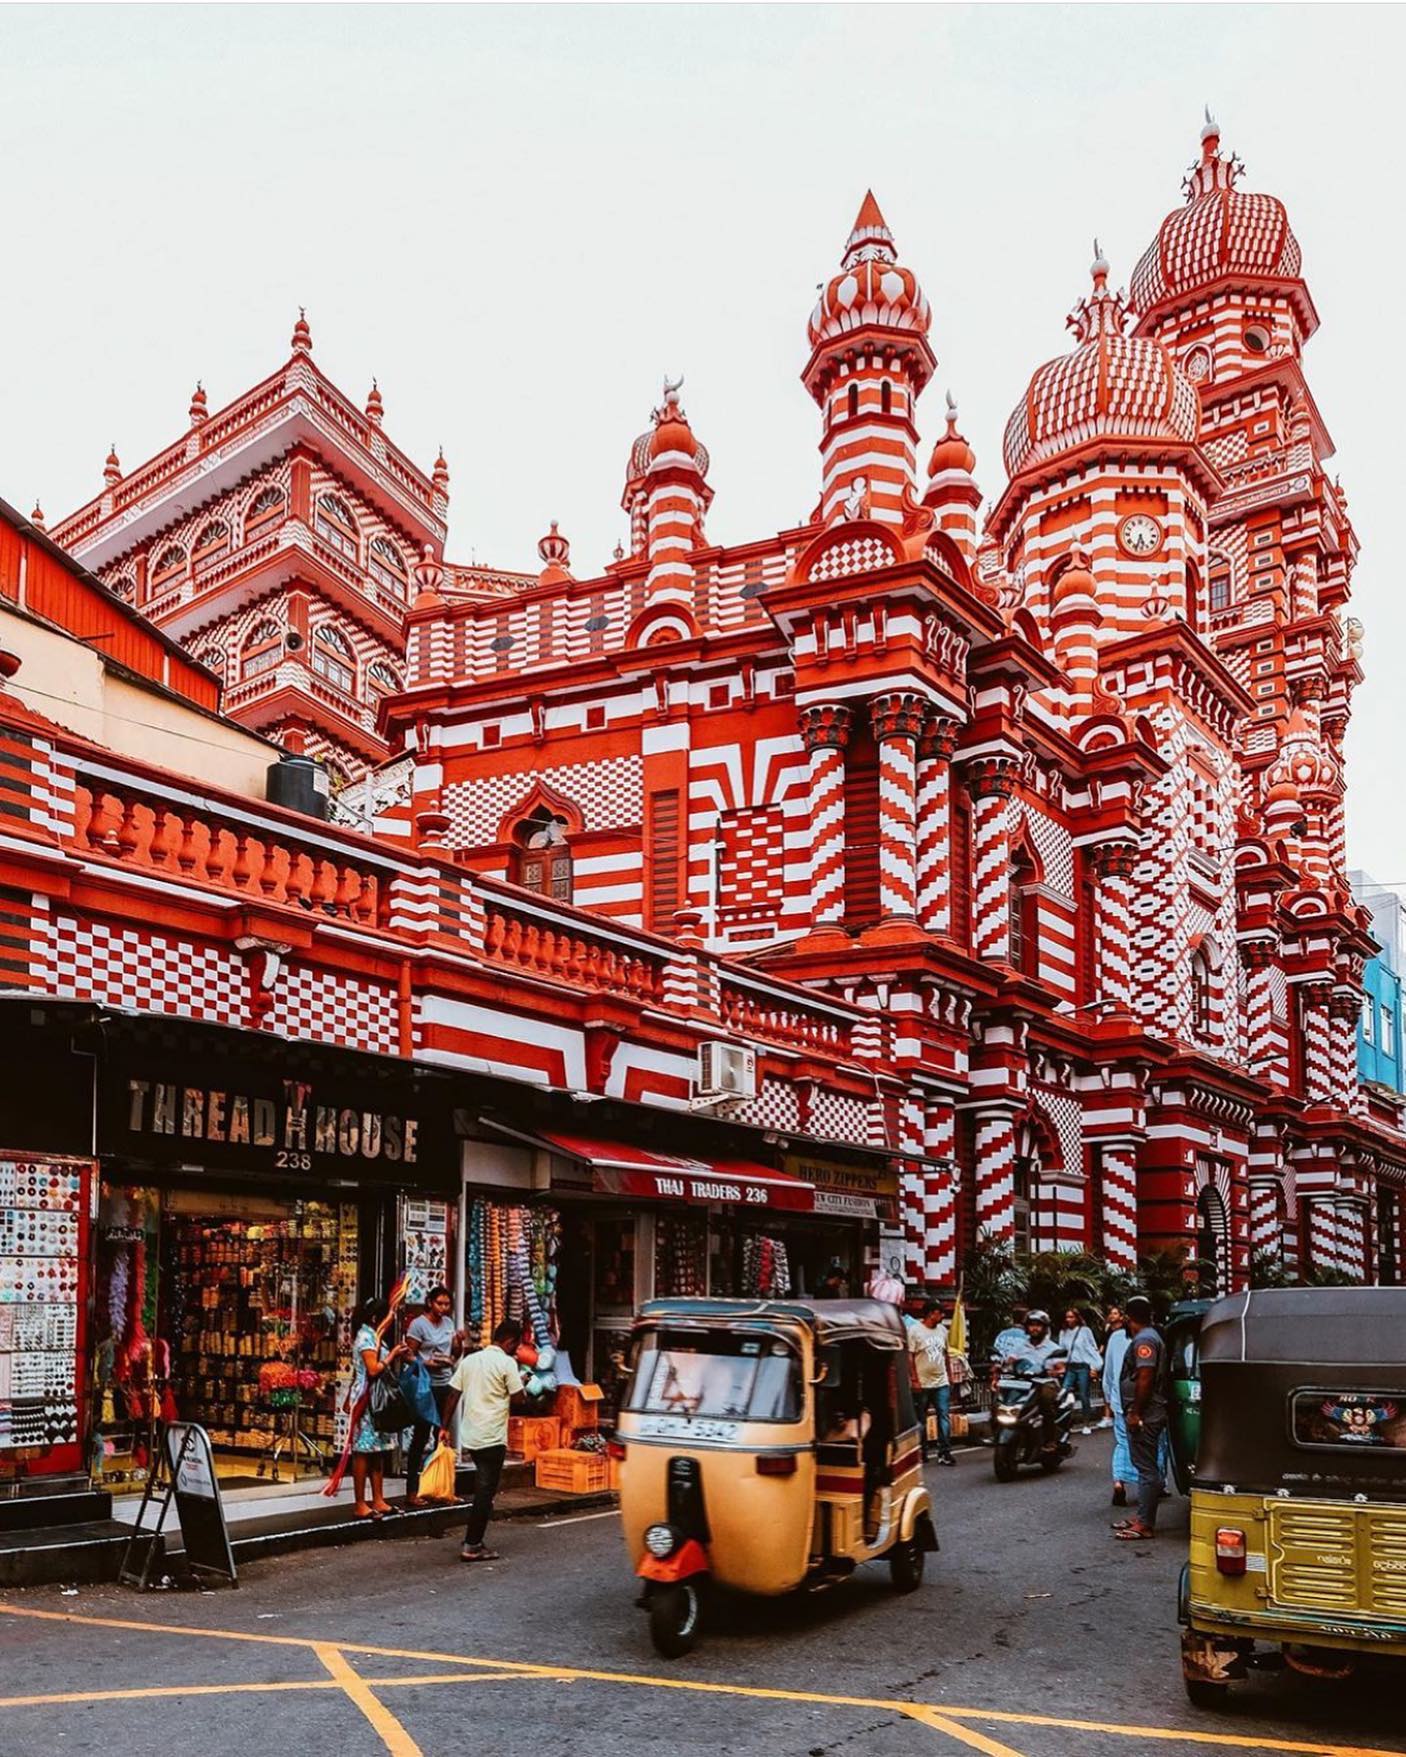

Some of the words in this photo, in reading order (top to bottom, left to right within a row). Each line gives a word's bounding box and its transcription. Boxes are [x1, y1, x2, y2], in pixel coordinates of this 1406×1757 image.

[129, 1079, 275, 1147] THREAD
[315, 1105, 419, 1163] HOUSE
[275, 1151, 312, 1171] 238
[654, 1177, 684, 1196] THAJ
[690, 1181, 741, 1201] TRADERS
[745, 1187, 769, 1204] 236
